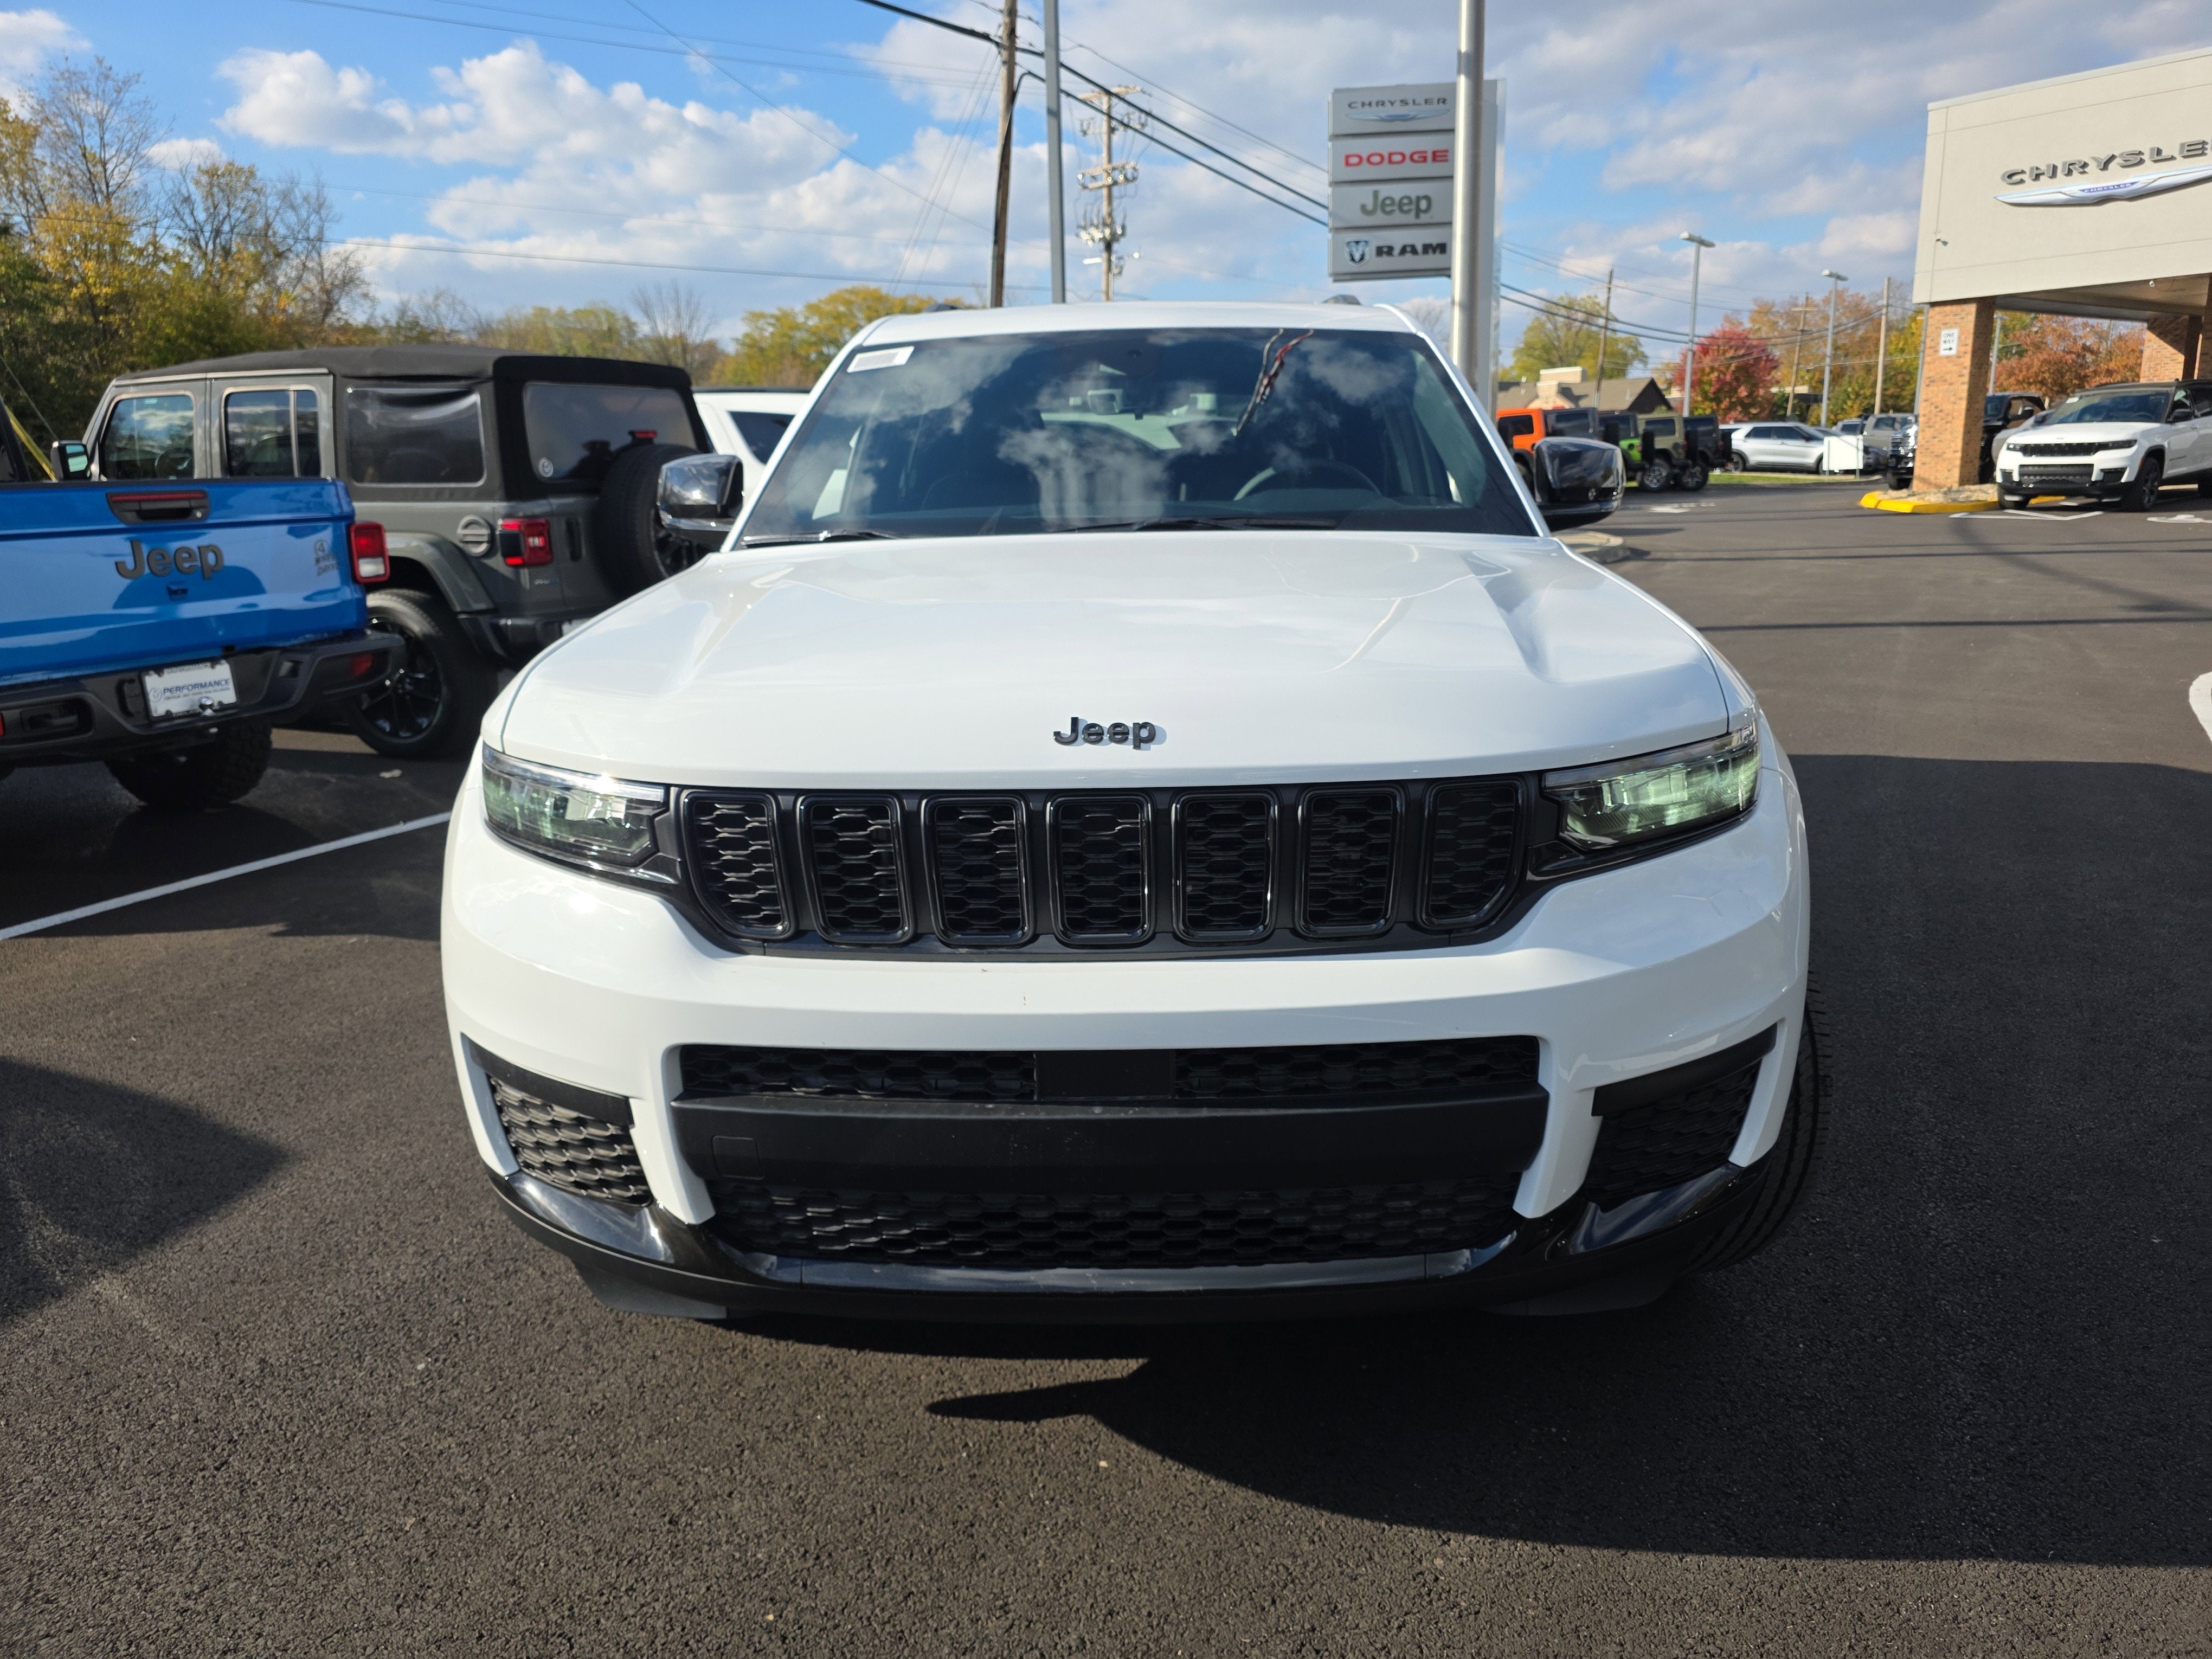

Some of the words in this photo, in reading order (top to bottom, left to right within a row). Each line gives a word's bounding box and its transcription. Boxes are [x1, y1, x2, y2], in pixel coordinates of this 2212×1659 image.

[1347, 97, 1448, 109] CHRYSLER
[1345, 149, 1449, 168] DODGE
[2001, 139, 2212, 184] CHRYSLE
[1360, 190, 1432, 218] Jeep
[1375, 243, 1447, 257] RAM
[115, 539, 224, 580] Jeep
[163, 678, 230, 695] PERFORMANCE
[1053, 717, 1156, 750] Jeep
